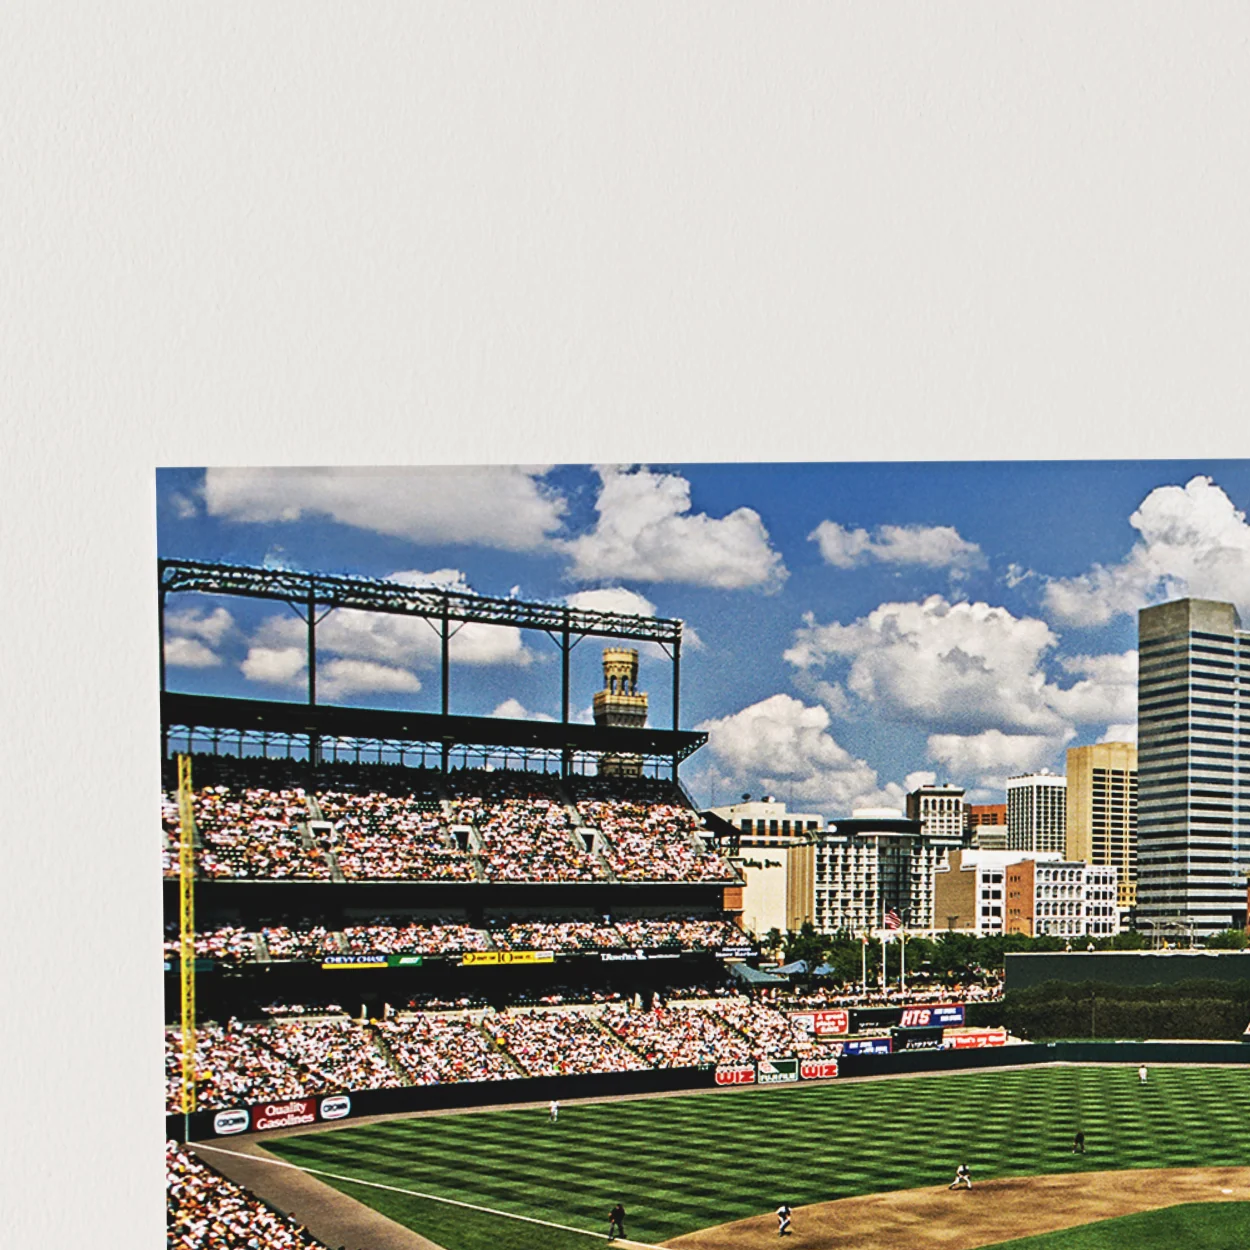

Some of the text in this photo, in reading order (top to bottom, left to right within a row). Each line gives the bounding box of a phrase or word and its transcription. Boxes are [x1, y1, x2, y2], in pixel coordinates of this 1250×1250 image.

[324, 954, 386, 964] CHEVY CHASE
[901, 1009, 931, 1025] HTS
[715, 1070, 756, 1085] WIZ
[801, 1064, 838, 1079] WIZ
[265, 1101, 308, 1117] Quality
[323, 1102, 348, 1113] CROWN
[216, 1116, 246, 1128] CROWN
[256, 1113, 314, 1130] Gasolines
